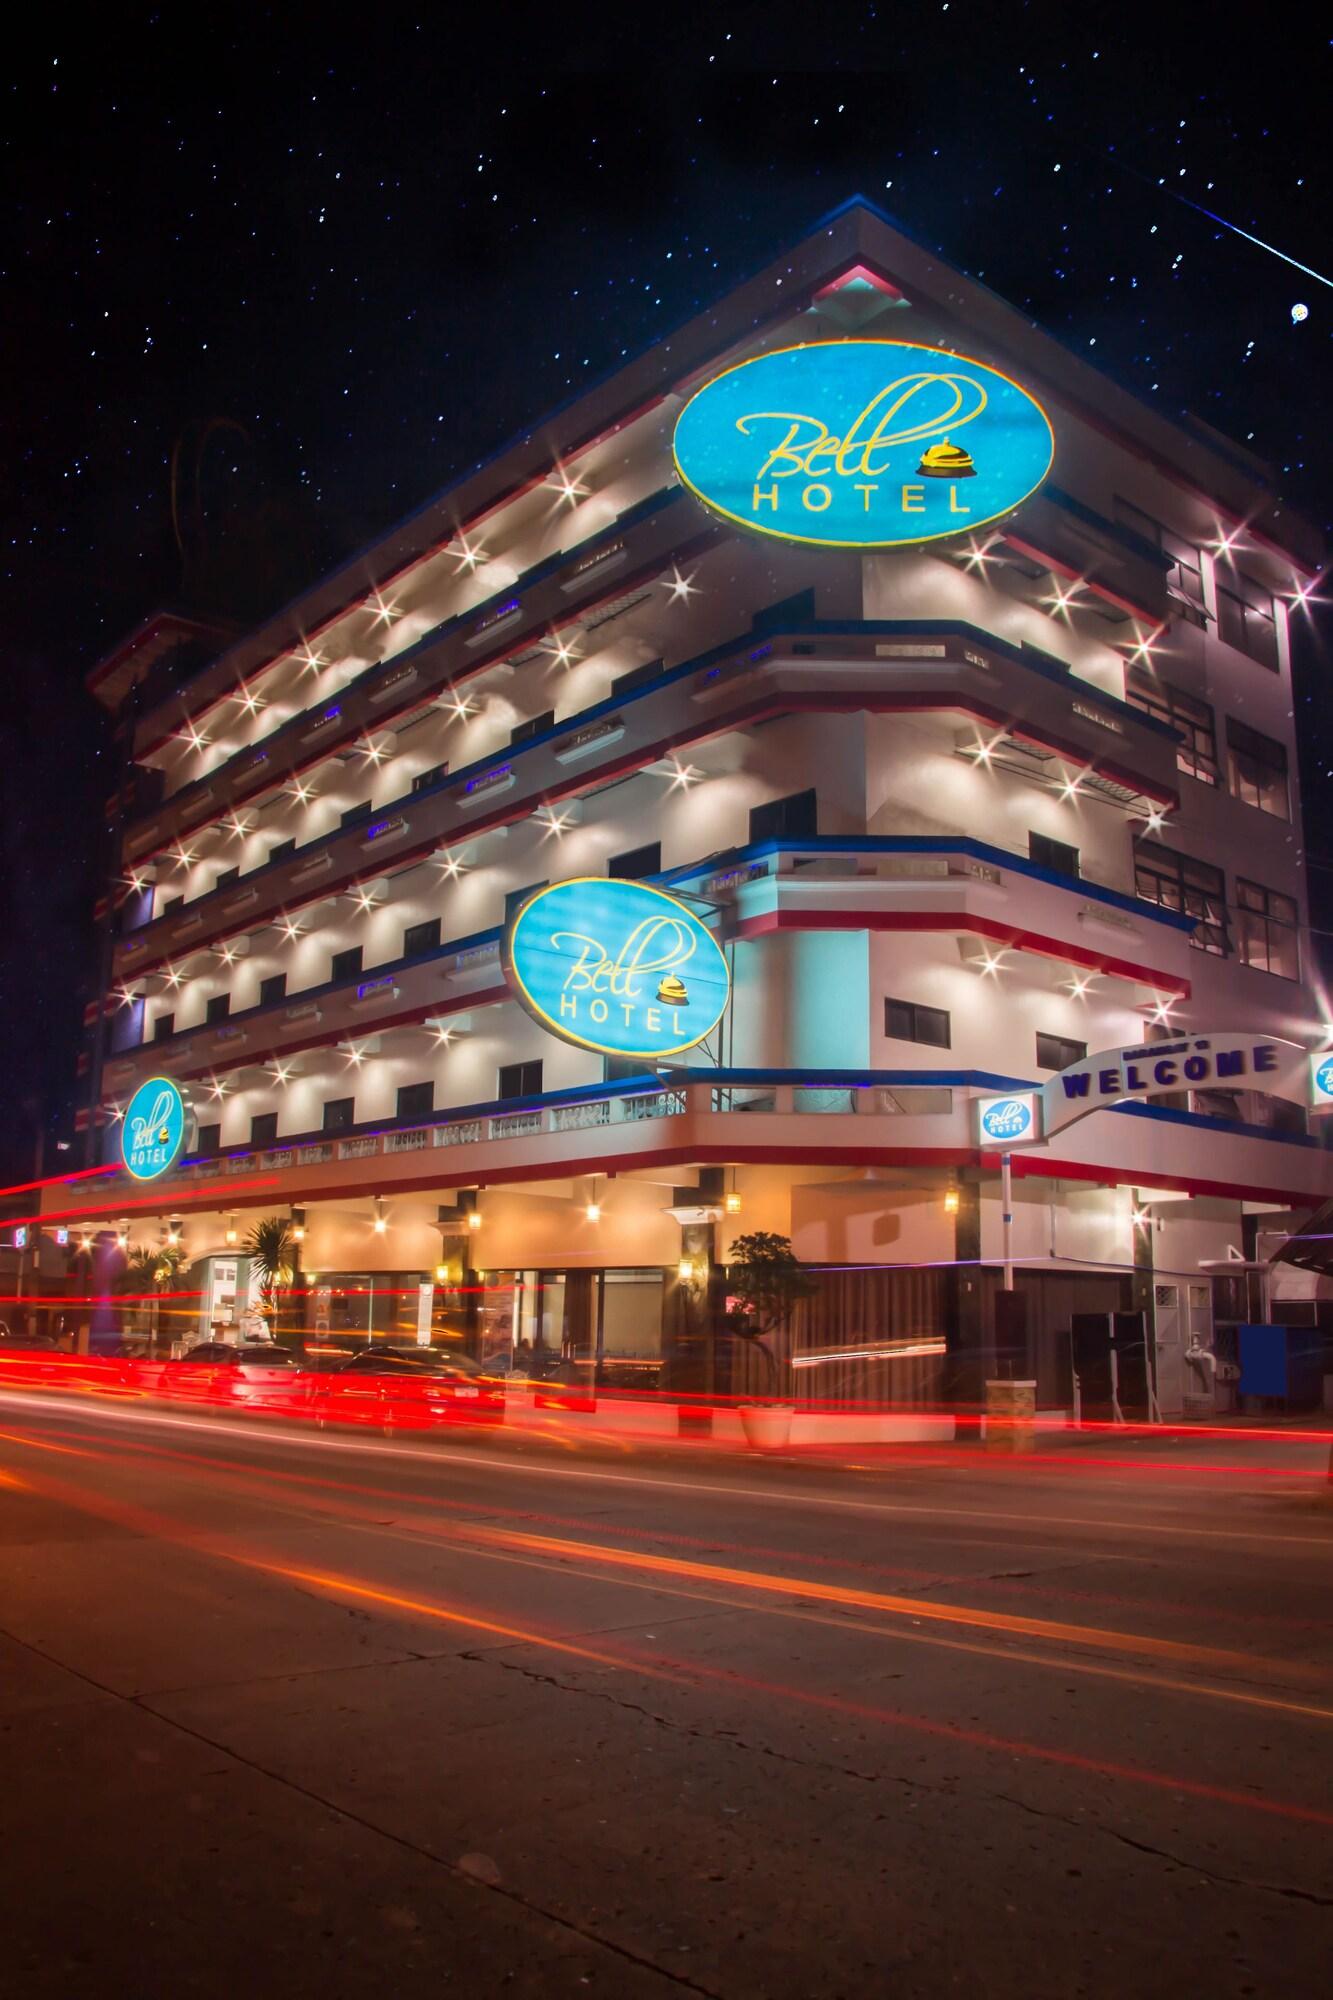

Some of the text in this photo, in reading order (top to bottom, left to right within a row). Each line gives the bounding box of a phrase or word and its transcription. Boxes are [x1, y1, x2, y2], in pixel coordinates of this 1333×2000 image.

[736, 373, 988, 480] Bell
[752, 484, 970, 513] HOTEL
[551, 916, 697, 996] Bell
[560, 993, 686, 1036] HOTEL
[1062, 1045, 1279, 1099] WELCOME
[131, 1091, 174, 1150] Bell
[985, 1102, 1023, 1126] Bell
[990, 1123, 1023, 1134] HOTEL
[130, 1148, 167, 1166] HOTEL
